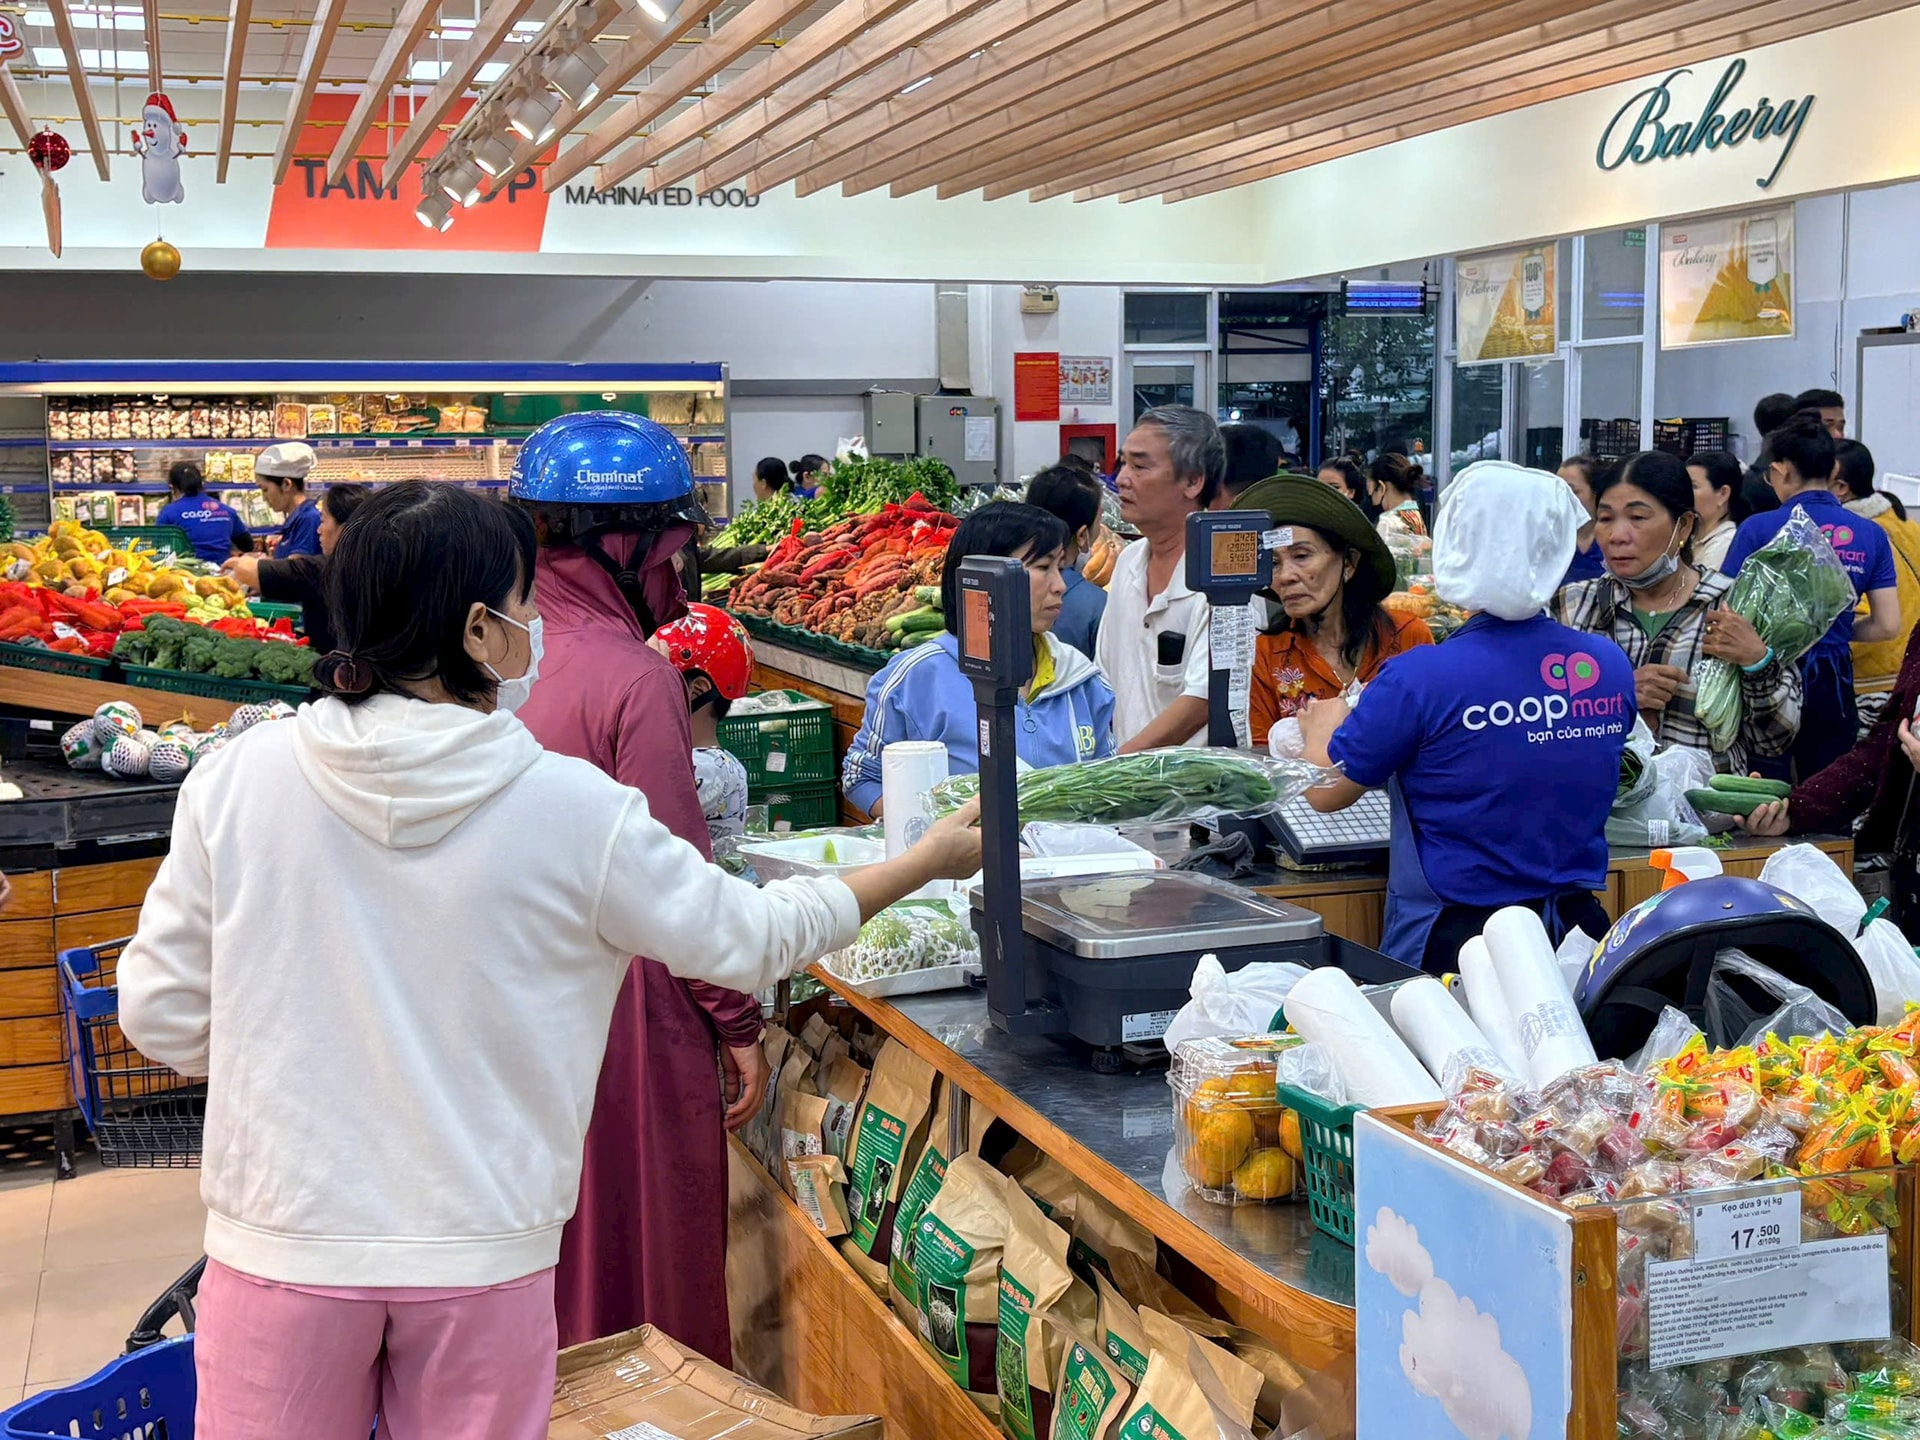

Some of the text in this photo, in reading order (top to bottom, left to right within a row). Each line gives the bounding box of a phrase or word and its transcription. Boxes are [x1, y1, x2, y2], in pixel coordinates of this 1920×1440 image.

[1595, 57, 1816, 189] Bakery
[1672, 247, 1717, 271] Bakery
[1465, 281, 1500, 300] Bakery
[1527, 730, 1554, 744] bạn
[1556, 726, 1582, 739] của
[1584, 724, 1605, 738] mọi
[1722, 1204, 1737, 1213] Kẹo
[1764, 1197, 1770, 1207] vị
[1772, 1197, 1782, 1205] kg
